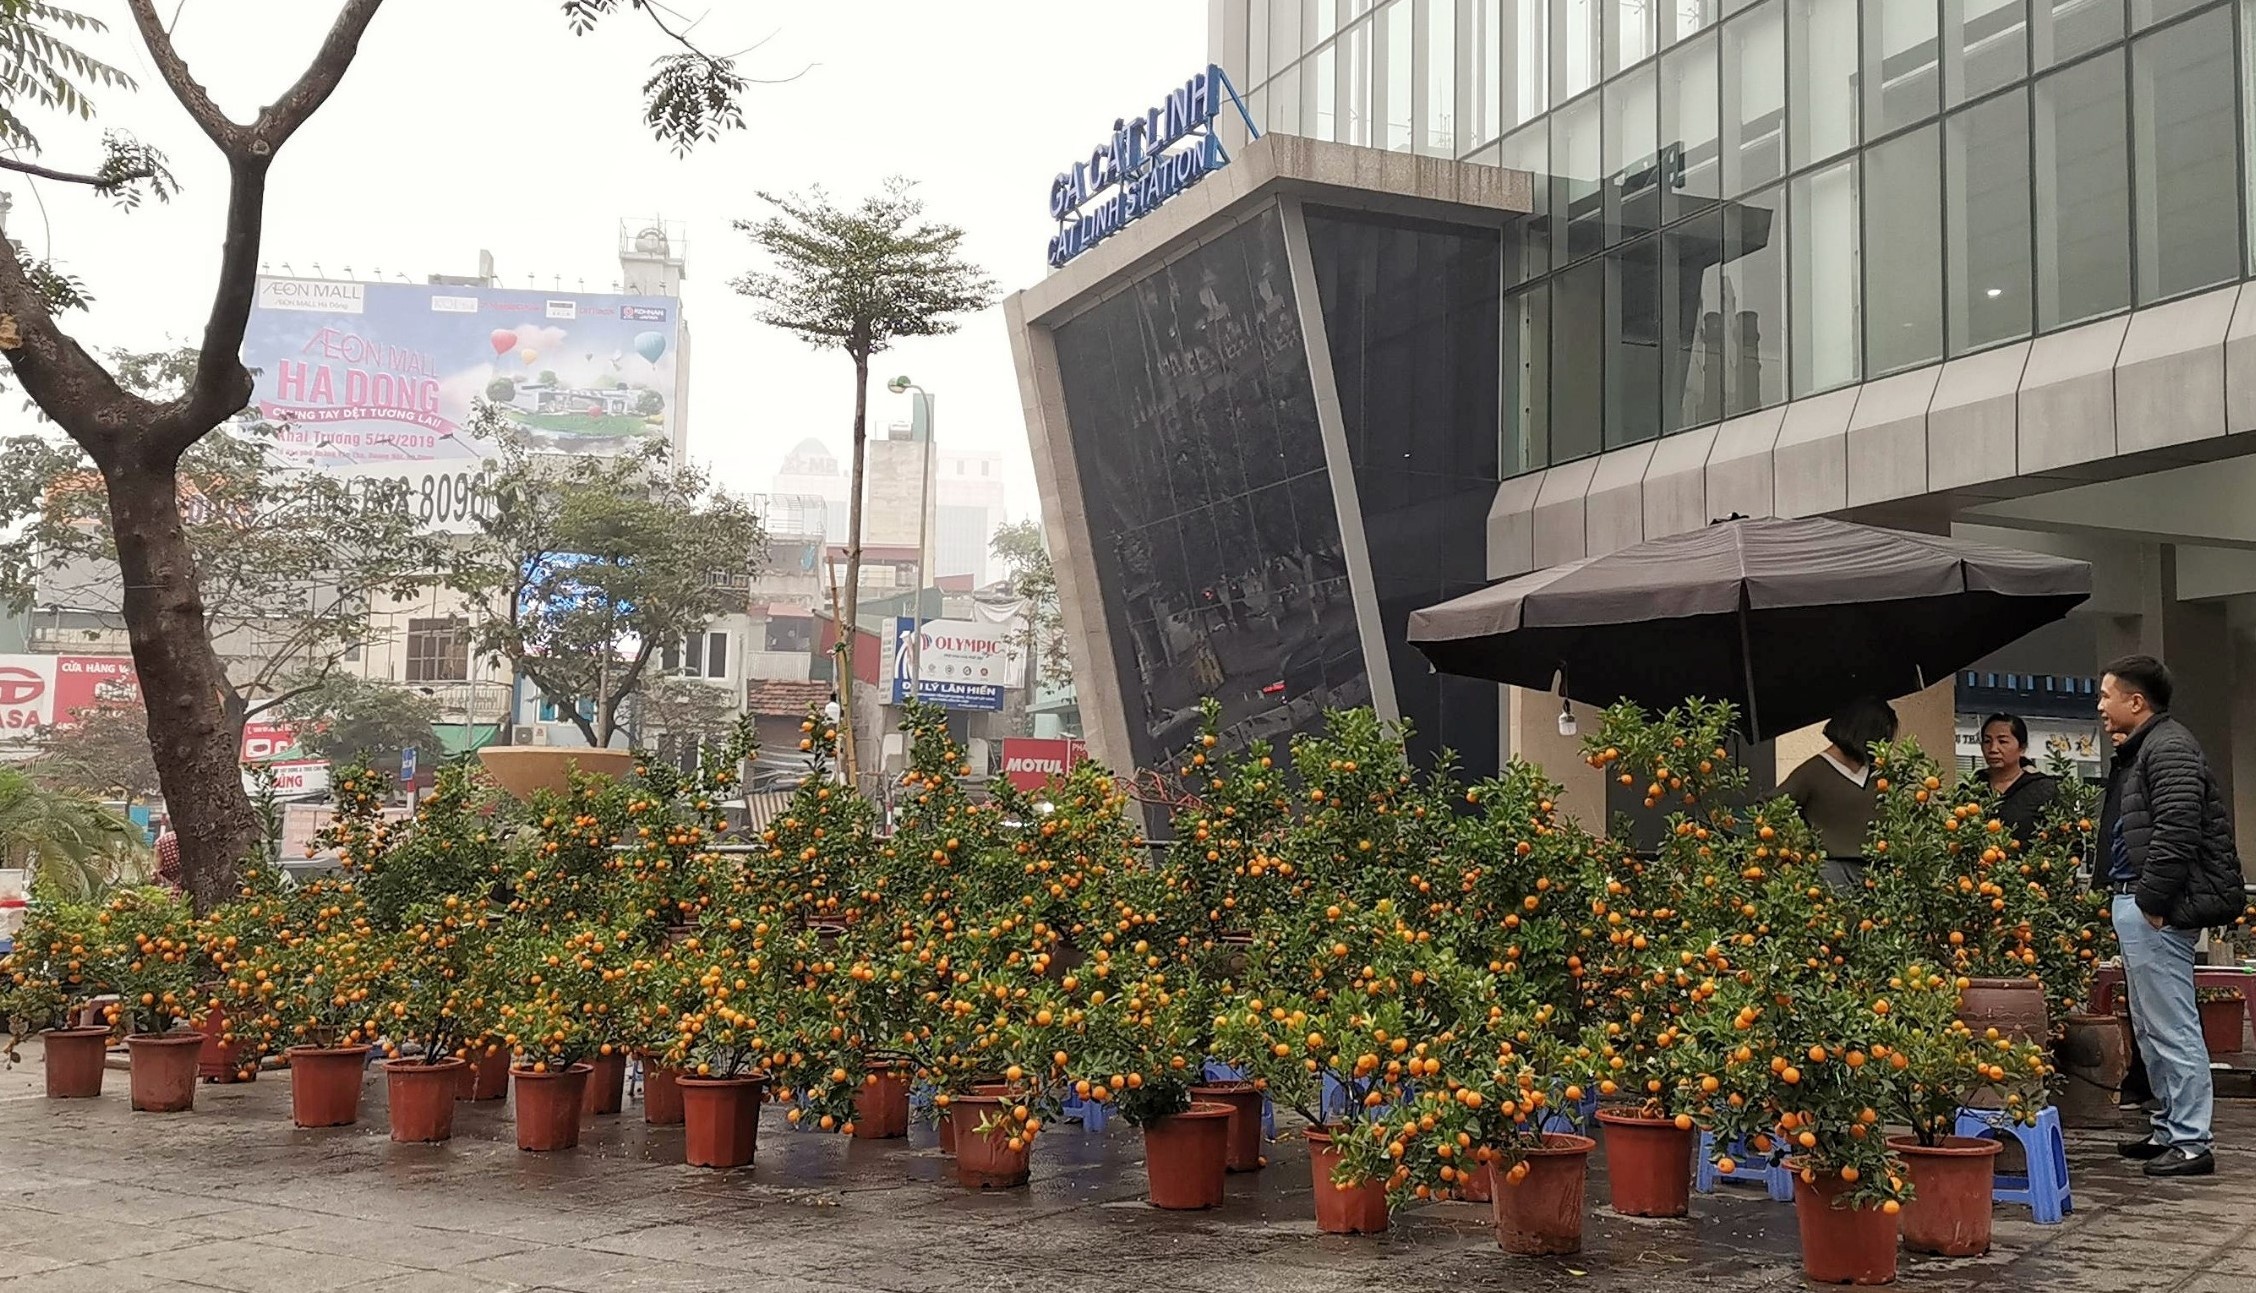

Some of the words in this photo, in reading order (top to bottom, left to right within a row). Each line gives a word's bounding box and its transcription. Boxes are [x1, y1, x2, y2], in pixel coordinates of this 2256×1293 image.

[1050, 160, 1087, 218] GA
[1146, 63, 1219, 156] LINH
[1081, 192, 1127, 244] LINH
[1126, 134, 1216, 216] STATION
[314, 283, 361, 300] MALL
[388, 344, 439, 378] MALL
[318, 409, 340, 420] TAY
[343, 406, 366, 420] DỆT
[370, 408, 416, 421] TƯƠNG
[935, 635, 1003, 655] OLYMPIC
[61, 660, 83, 673] CỬA
[85, 660, 116, 673] HÀNG
[902, 681, 923, 693] ĐI
[1006, 758, 1063, 774] MOTUL
